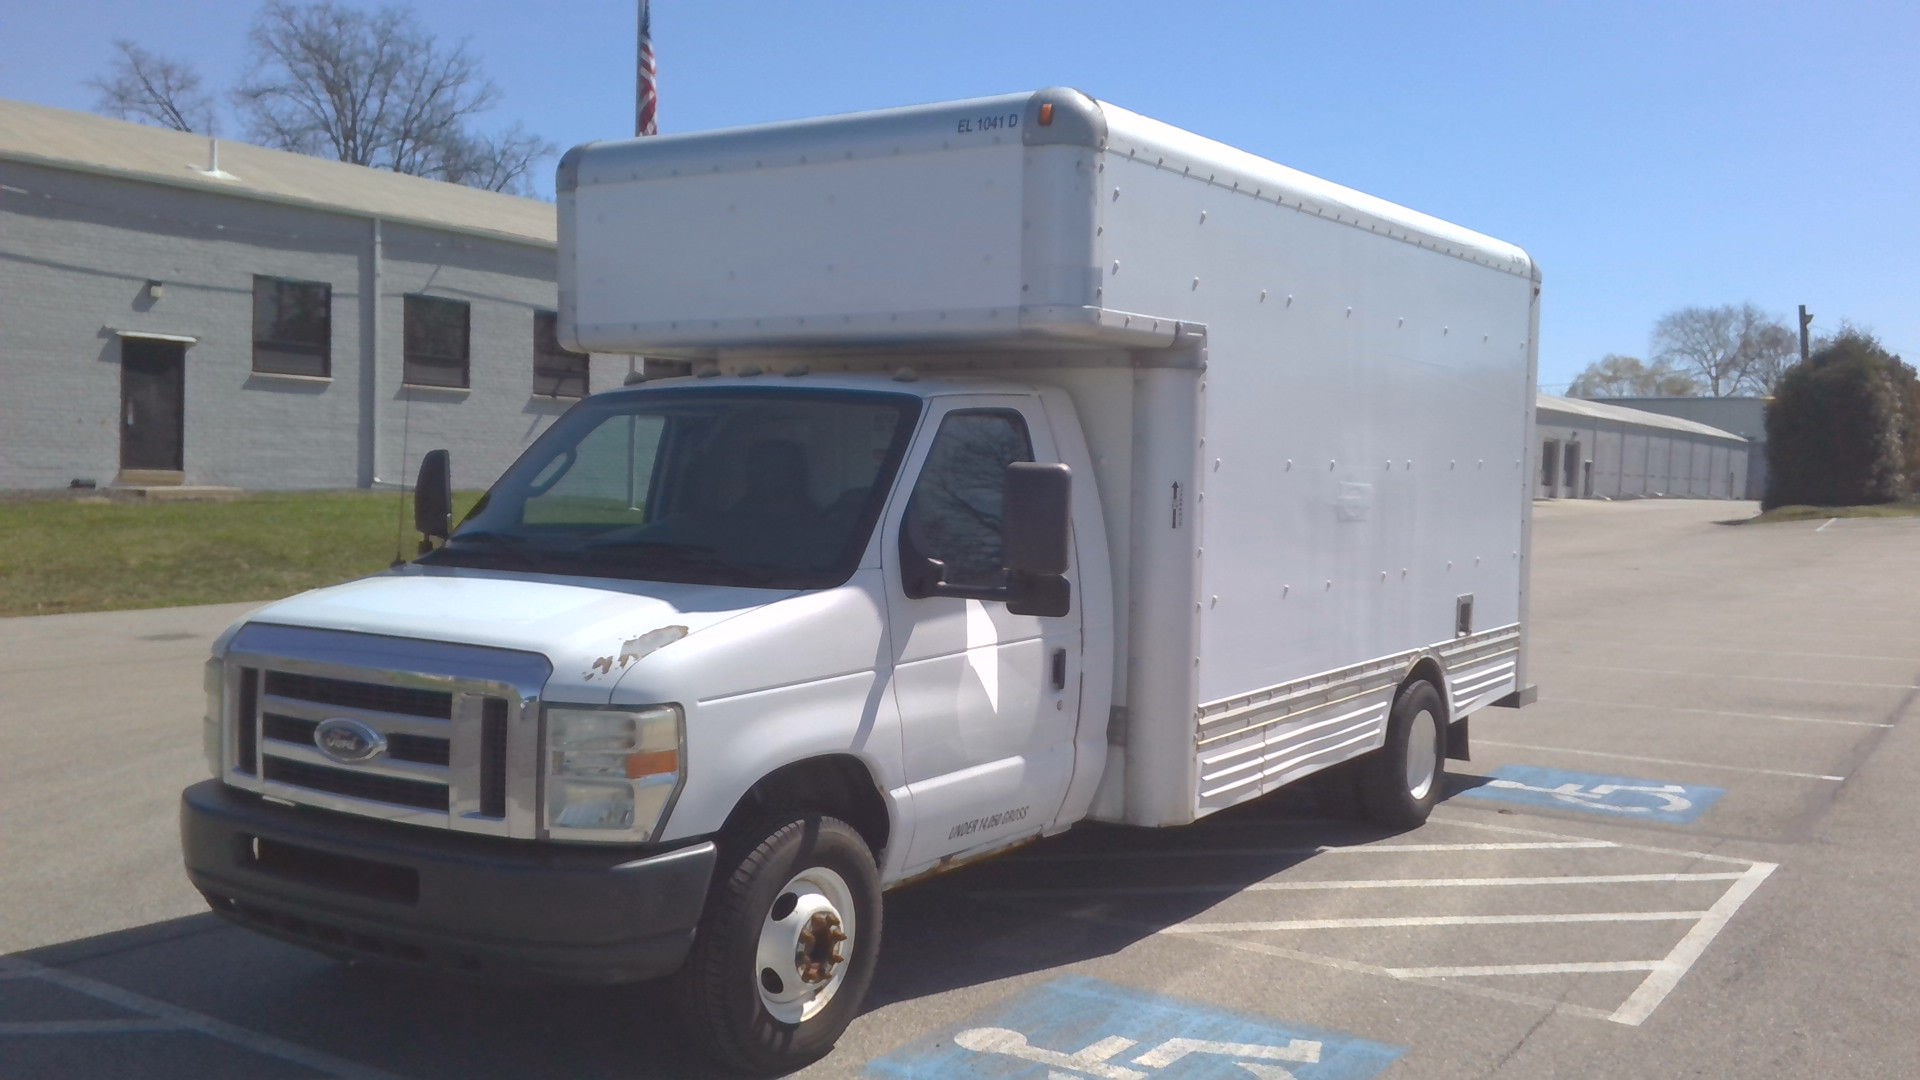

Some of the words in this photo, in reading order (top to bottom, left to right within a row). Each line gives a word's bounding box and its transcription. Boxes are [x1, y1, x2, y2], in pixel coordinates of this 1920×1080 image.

[957, 118, 973, 134] EL
[977, 115, 1004, 131] 1041
[1008, 113, 1018, 128] D
[948, 818, 979, 840] UNDER
